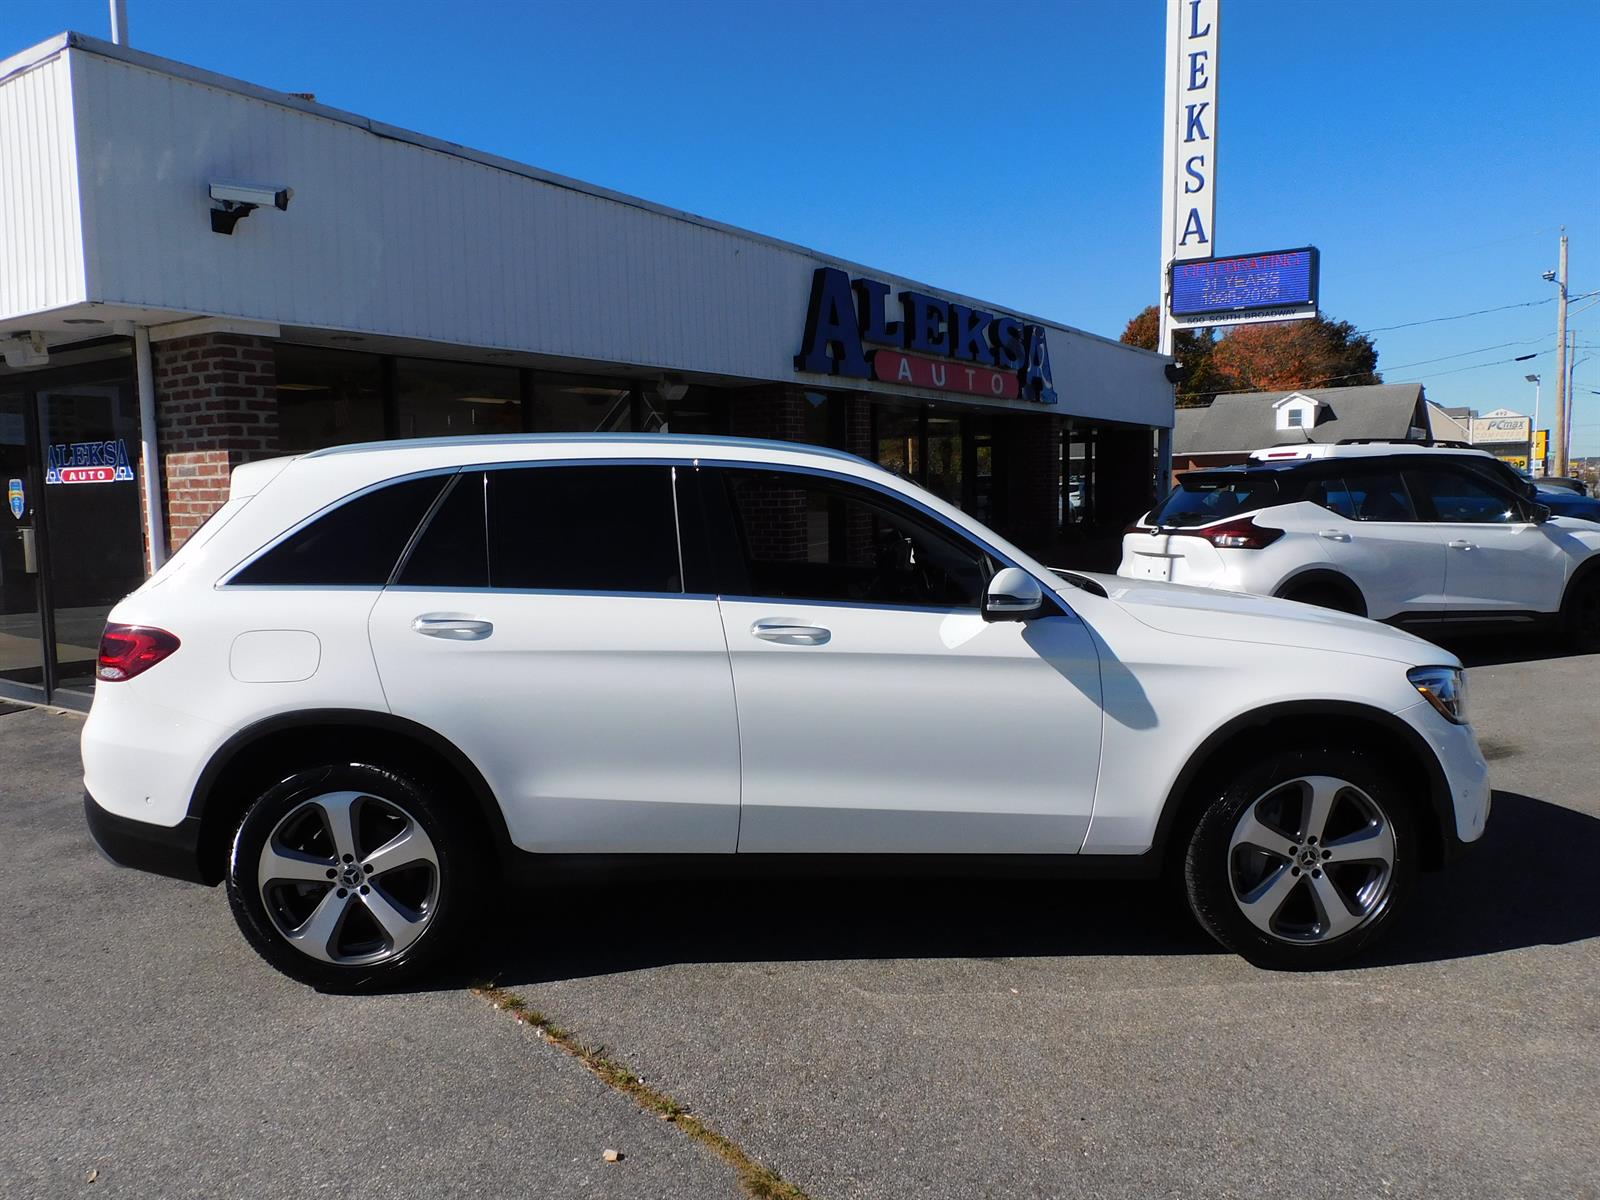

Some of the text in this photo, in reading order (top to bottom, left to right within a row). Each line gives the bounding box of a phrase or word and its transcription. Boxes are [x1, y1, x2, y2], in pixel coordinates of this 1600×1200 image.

[1225, 271, 1281, 288] YEARS
[1209, 313, 1241, 322] SOUTH
[1245, 309, 1297, 319] BROADWAY
[794, 267, 1058, 404] ALEKSA
[897, 357, 1004, 395] AUTO
[45, 438, 135, 485] ALEKSA
[69, 470, 106, 481] AUTO
